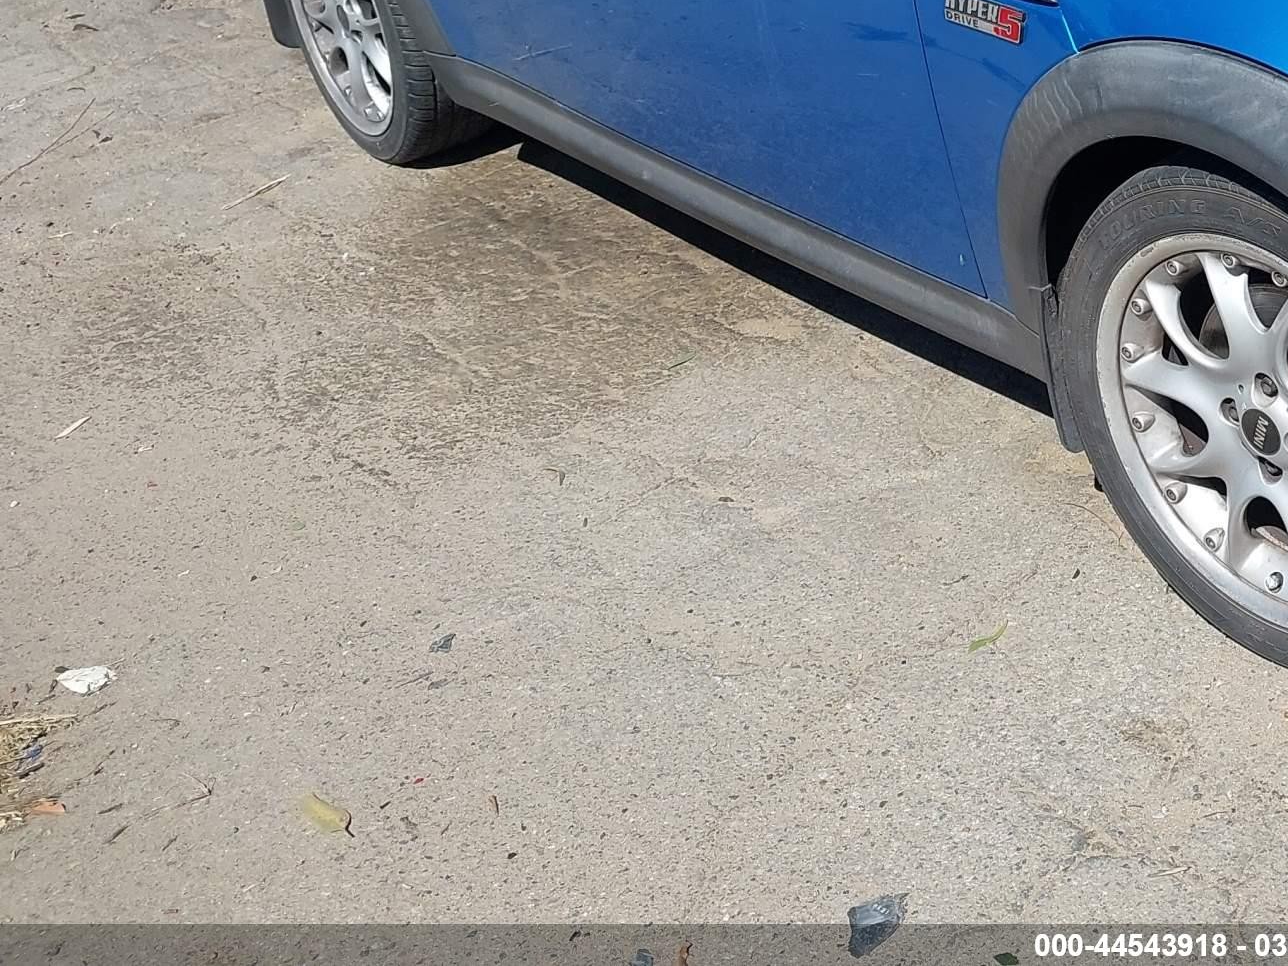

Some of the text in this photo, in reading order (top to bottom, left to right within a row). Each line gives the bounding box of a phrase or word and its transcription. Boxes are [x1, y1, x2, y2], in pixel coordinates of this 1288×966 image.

[946, 10, 980, 29] DRIVE
[1098, 198, 1209, 250] TOURING
[1253, 415, 1269, 450] MINI
